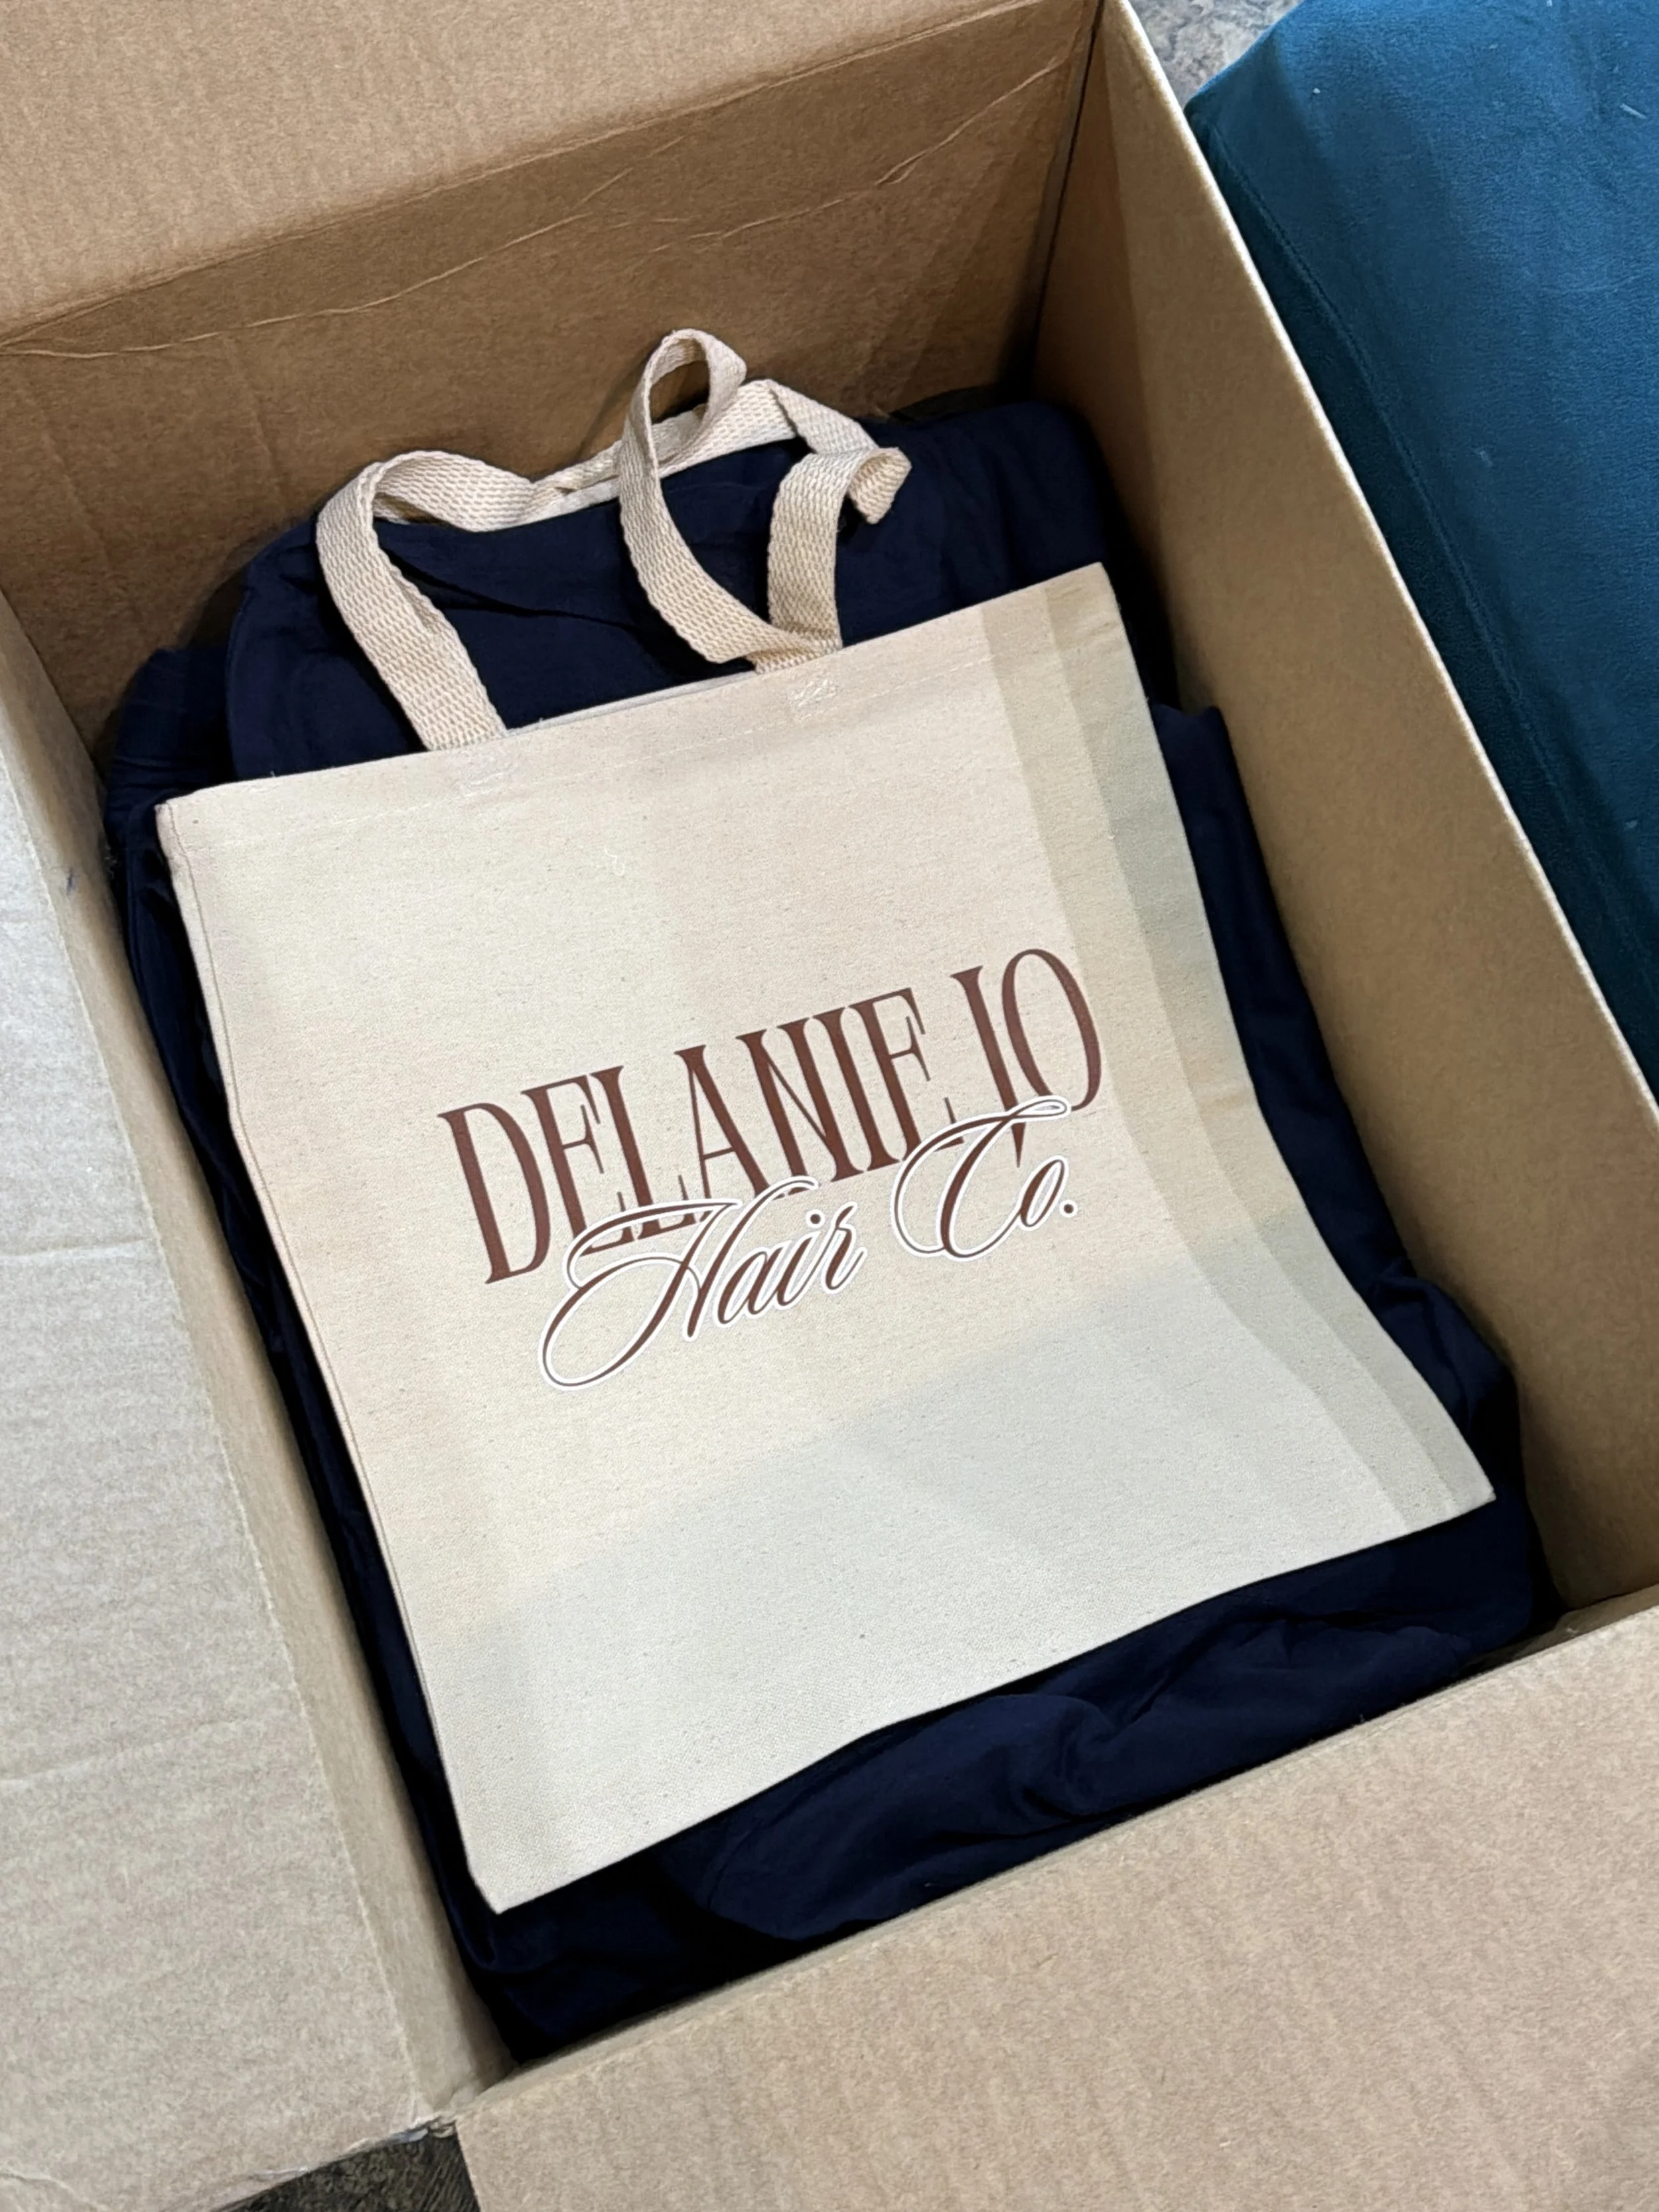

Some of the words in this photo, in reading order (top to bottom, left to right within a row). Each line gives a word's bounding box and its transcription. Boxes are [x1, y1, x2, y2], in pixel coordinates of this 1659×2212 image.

[437, 988, 965, 1284] DELANIE
[950, 948, 1102, 1168] JO
[539, 1176, 867, 1390] Hair
[891, 1095, 1078, 1261] Co.
